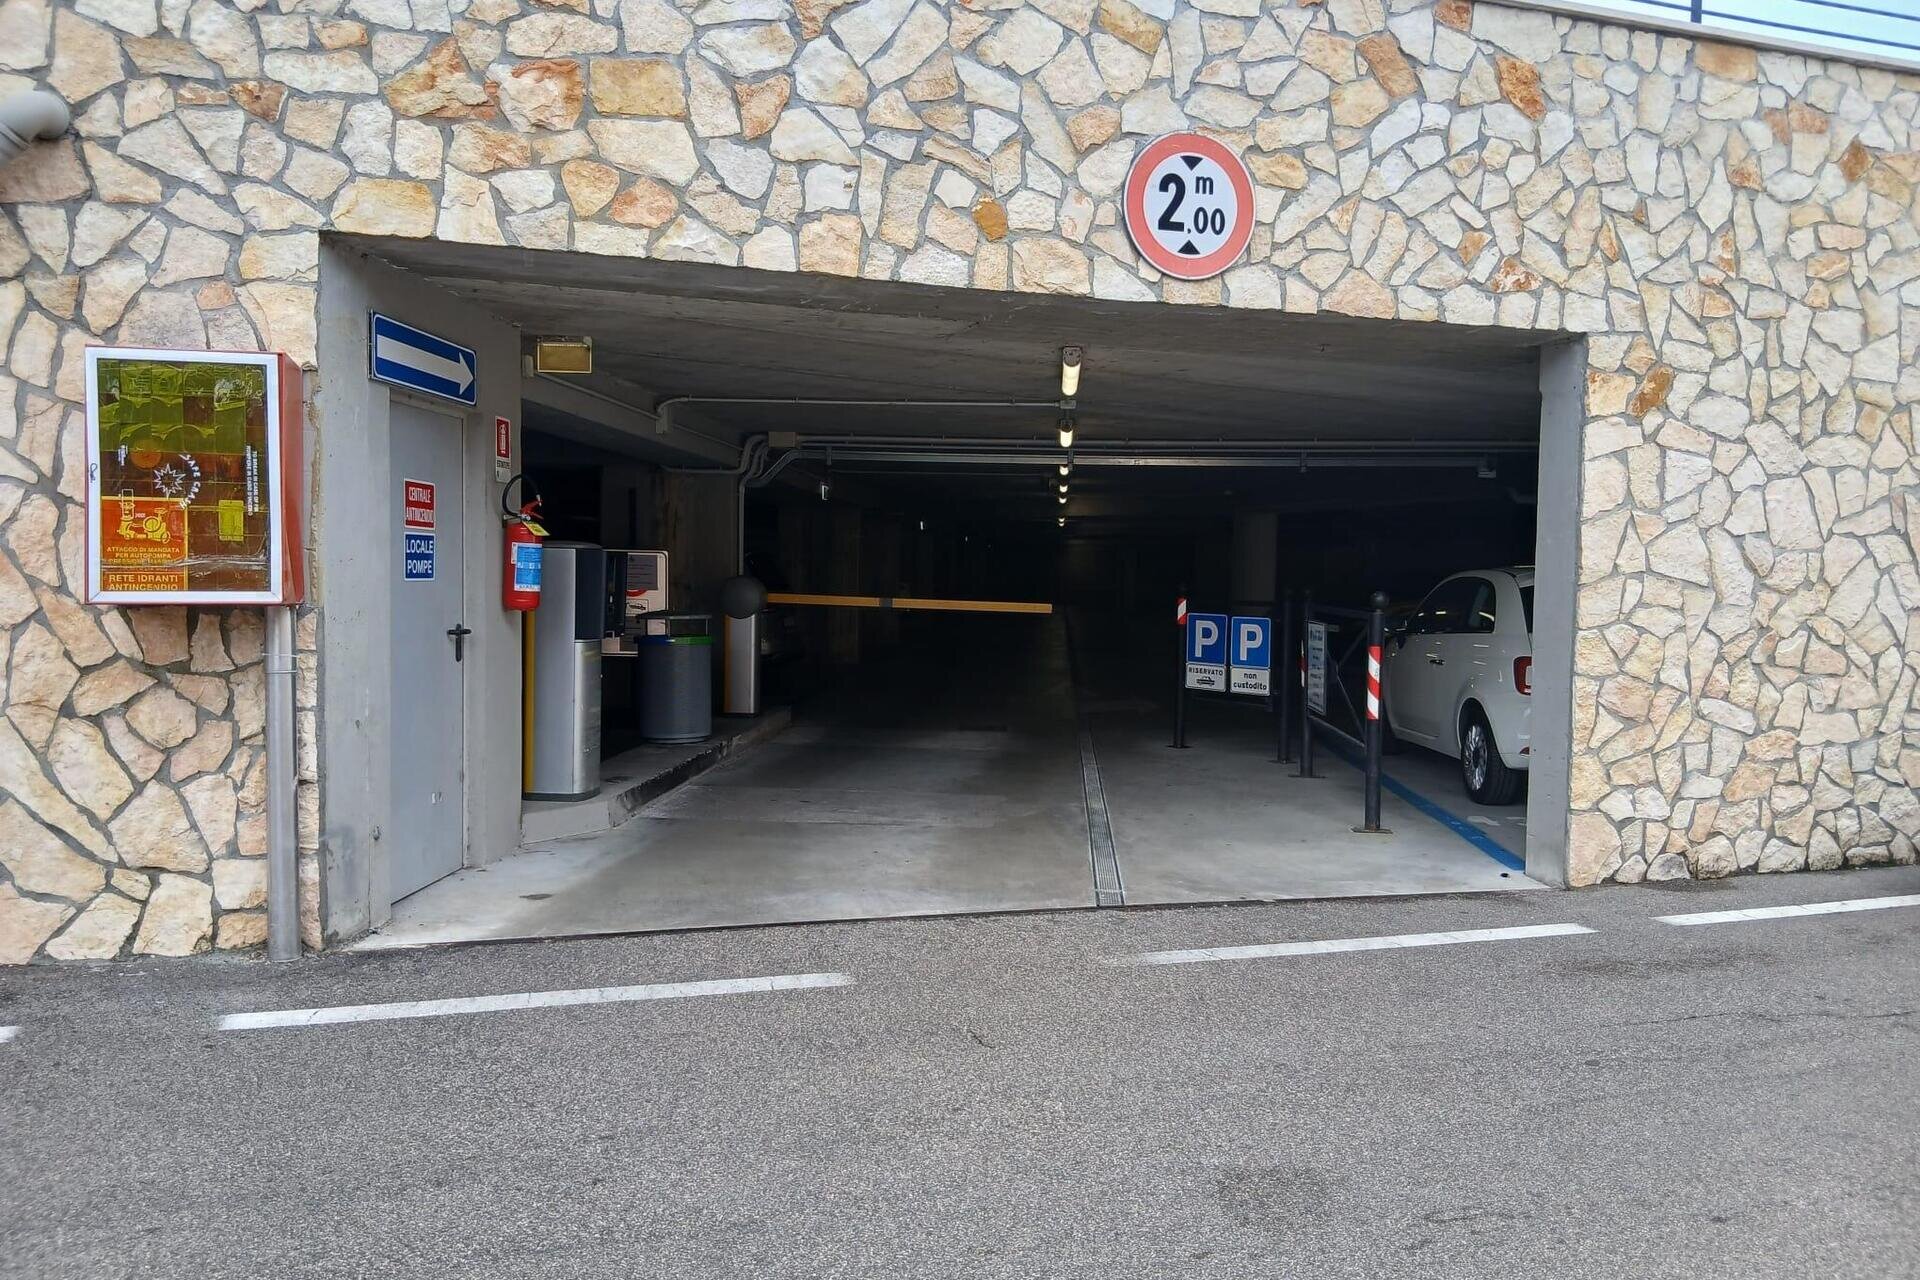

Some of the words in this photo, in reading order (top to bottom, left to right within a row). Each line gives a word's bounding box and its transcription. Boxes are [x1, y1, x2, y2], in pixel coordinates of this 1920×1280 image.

[1195, 175, 1214, 195] m
[179, 453, 200, 477] SAFE
[179, 482, 200, 510] CRASH
[408, 486, 431, 503] CENTRALE
[406, 539, 434, 554] LOCALE
[407, 560, 432, 574] POMPE
[109, 574, 135, 582] RETE
[137, 574, 178, 582] IDRANTI
[109, 583, 178, 591] ANTINCENDIO
[1195, 620, 1218, 657] P
[1240, 623, 1263, 660] P
[1188, 666, 1224, 676] RISERVATO
[1243, 672, 1257, 680] non
[1233, 681, 1267, 690] custodito
